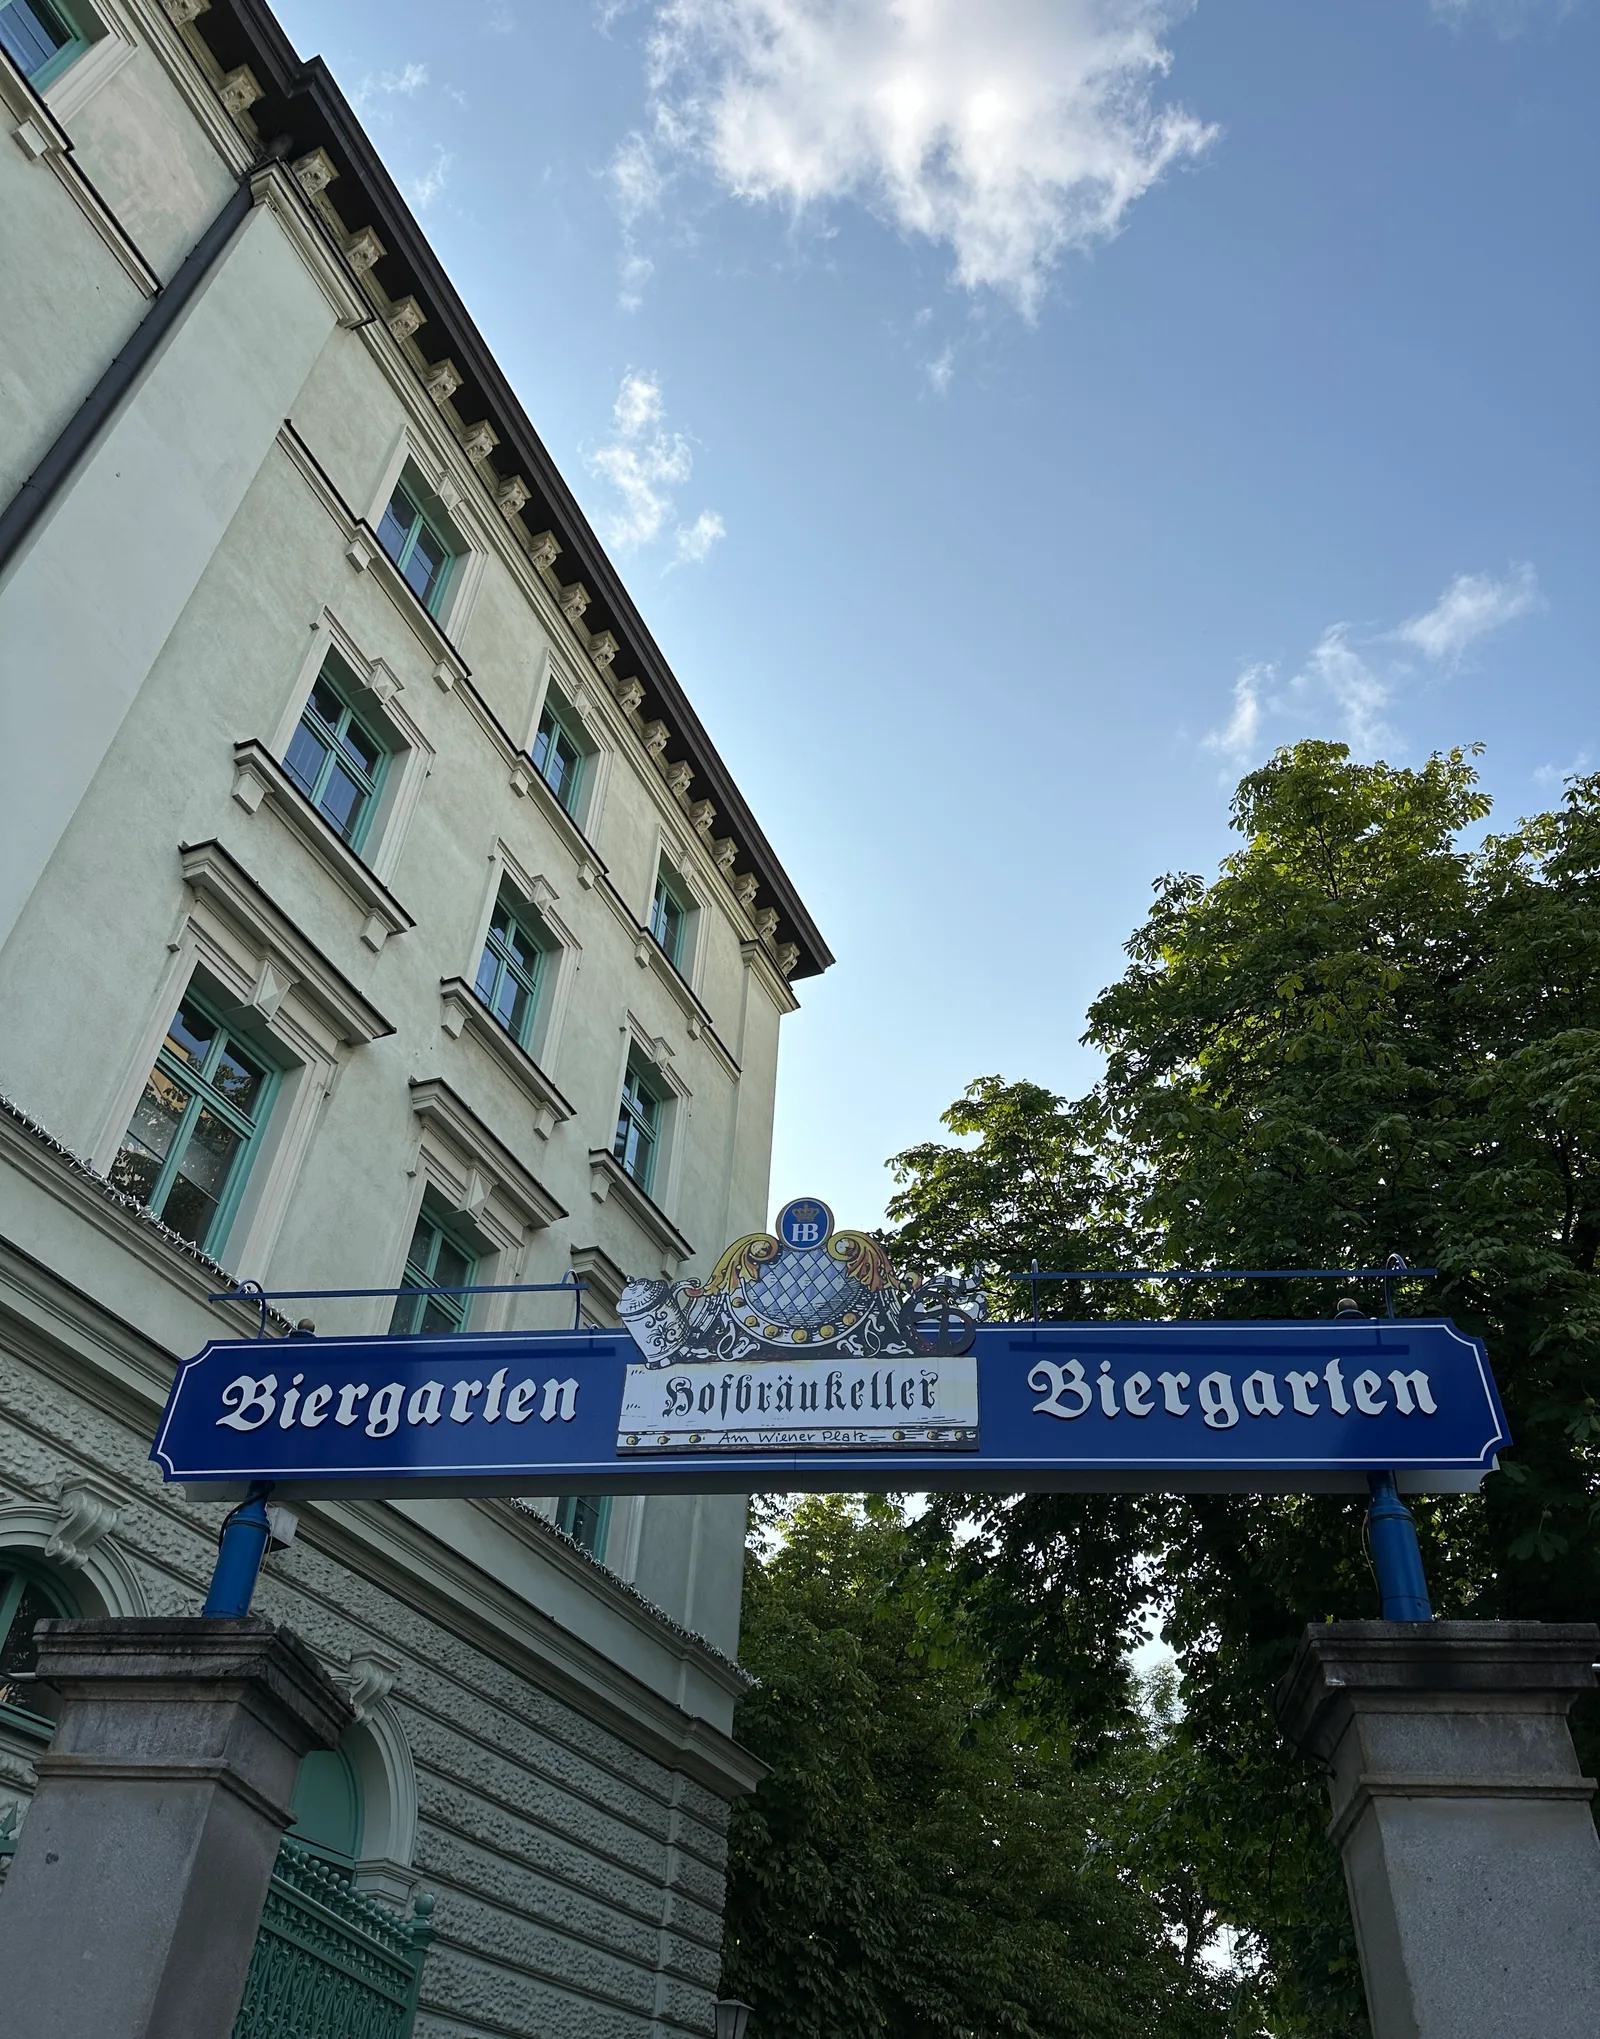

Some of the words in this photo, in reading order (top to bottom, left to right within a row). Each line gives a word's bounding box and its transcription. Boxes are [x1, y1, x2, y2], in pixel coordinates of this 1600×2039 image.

[791, 1223, 819, 1242] HB
[215, 1367, 580, 1438] Biergarten
[662, 1369, 939, 1420] Hofbräukeller
[1027, 1358, 1438, 1429] Biergarten
[717, 1431, 749, 1444] Am
[758, 1431, 816, 1443] Wiener
[822, 1430, 868, 1442] Platz
